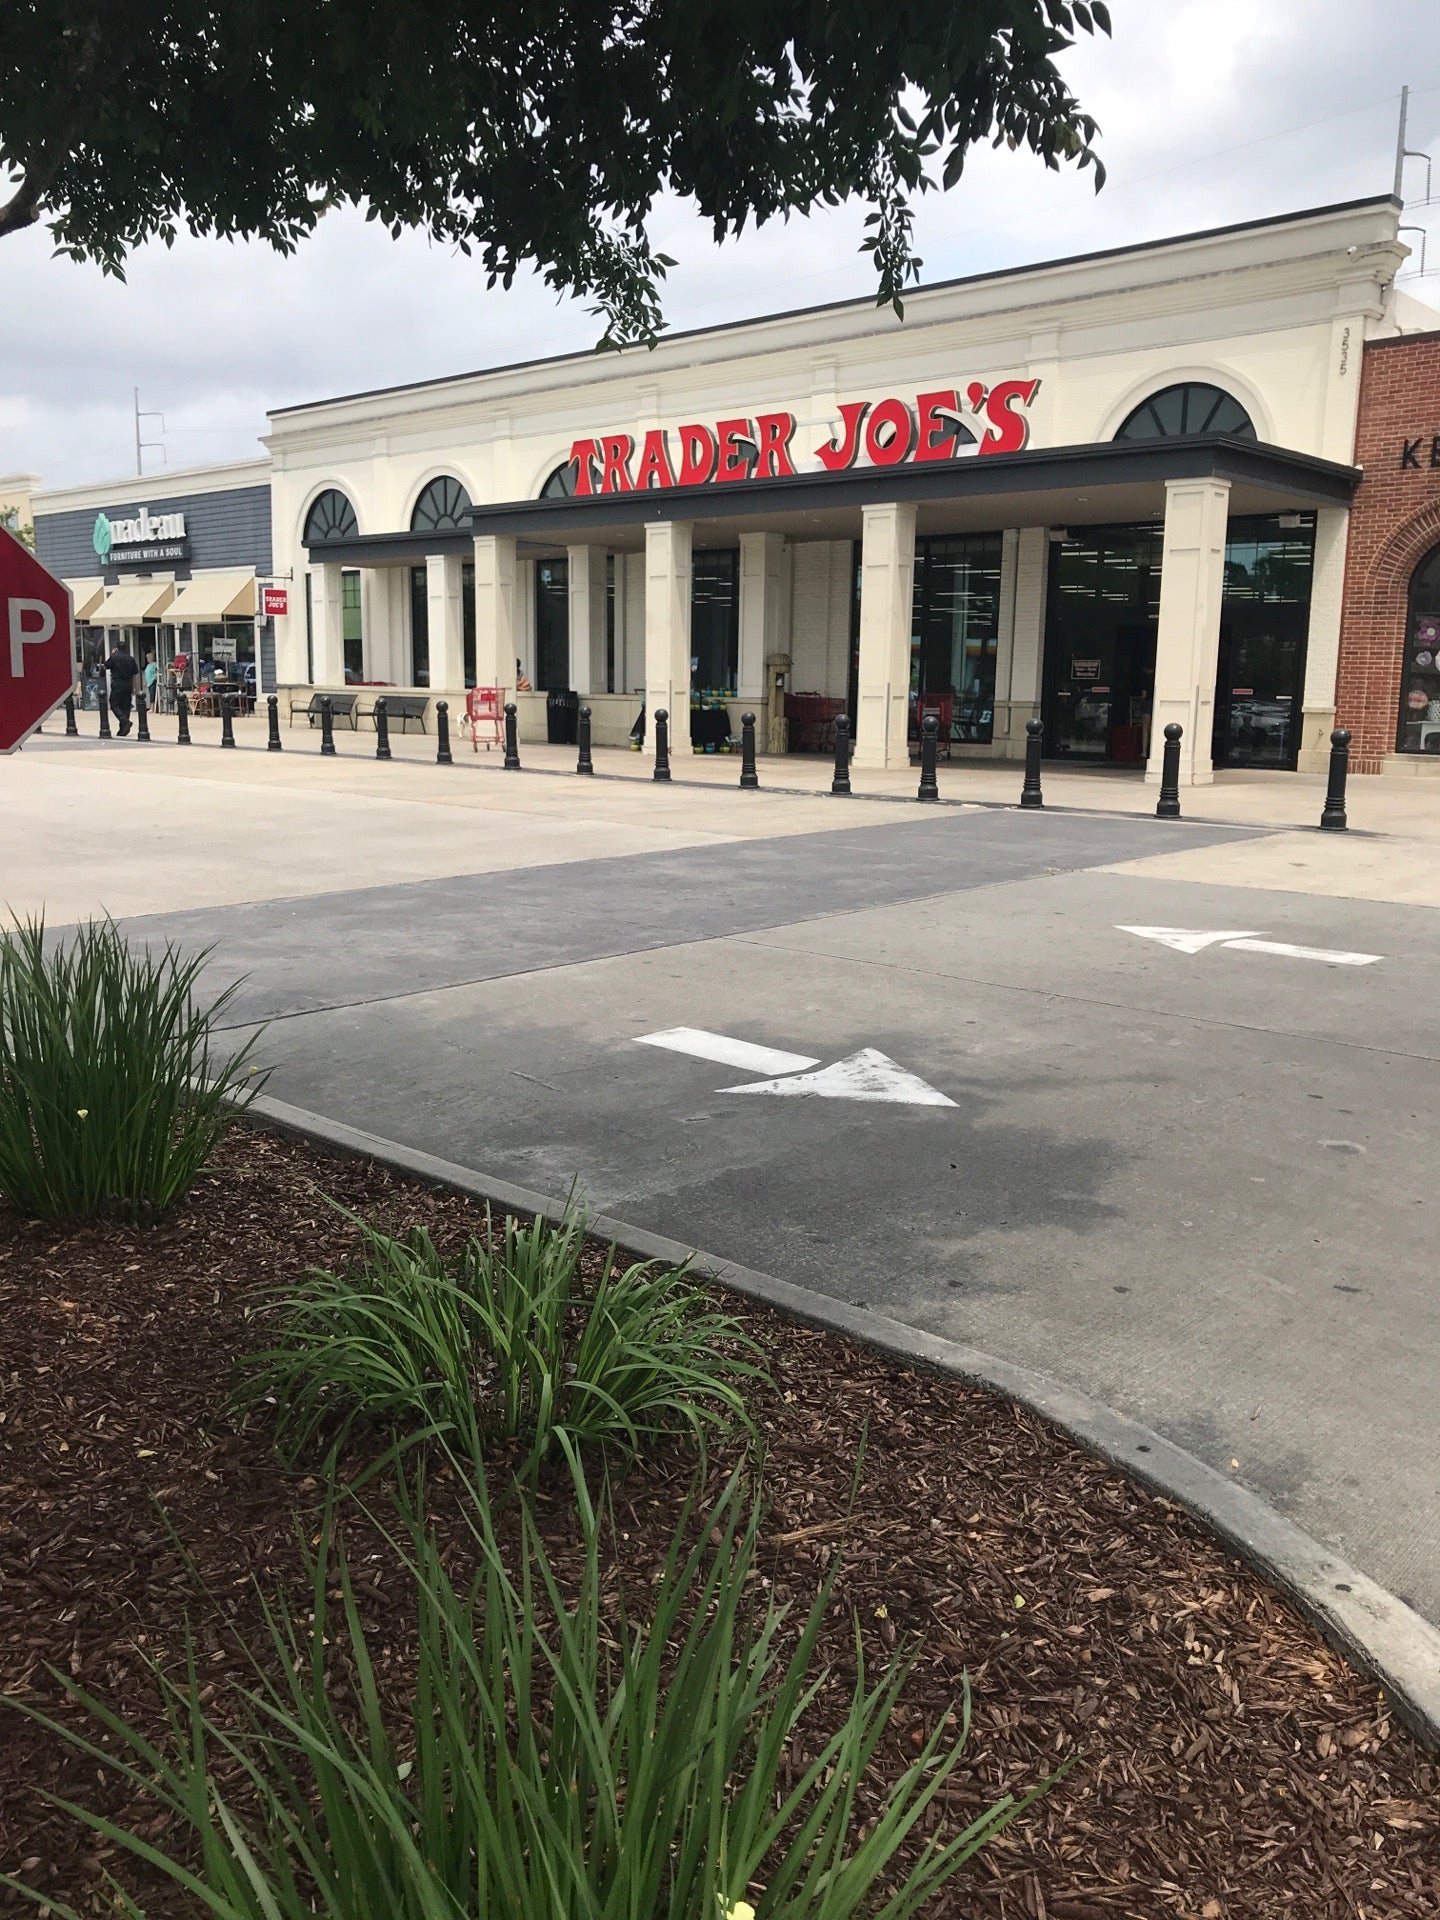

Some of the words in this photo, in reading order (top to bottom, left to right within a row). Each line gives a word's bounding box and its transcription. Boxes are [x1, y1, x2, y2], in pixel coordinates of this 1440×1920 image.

[1340, 327, 1350, 375] 3535
[568, 412, 797, 496] TRADER
[814, 379, 1041, 470] JOE'S
[109, 507, 187, 544] nadeau
[110, 550, 141, 561] FURNITURE
[143, 549, 158, 558] WITH
[160, 549, 165, 557] A
[166, 547, 183, 556] SOUL
[8, 597, 56, 678] P
